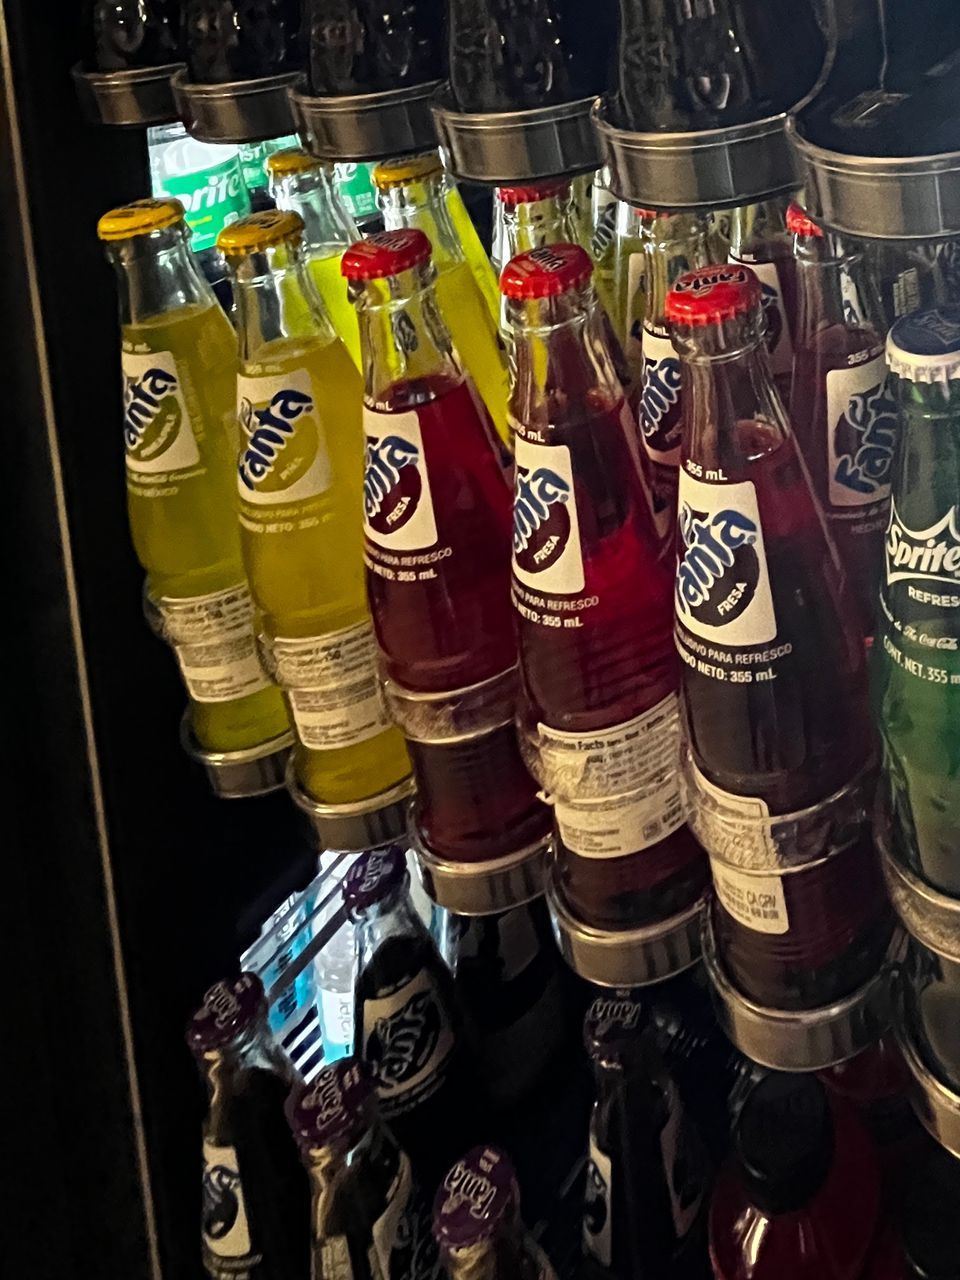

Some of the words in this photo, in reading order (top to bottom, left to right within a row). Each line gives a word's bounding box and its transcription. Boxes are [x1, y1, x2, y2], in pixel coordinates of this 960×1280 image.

[125, 368, 178, 451] anta
[527, 429, 546, 444] mL
[364, 434, 420, 520] anta
[686, 457, 704, 478] 355
[704, 468, 728, 481] mL
[385, 495, 411, 526] FRESA
[512, 467, 570, 554] anta
[533, 534, 561, 566] FRESA
[546, 595, 600, 612] REFRESCO
[716, 581, 748, 616] FRESA
[541, 613, 563, 628] 355
[563, 614, 585, 627] mL
[708, 648, 733, 664] PARA
[735, 643, 793, 665] REFRESCO
[697, 661, 728, 680] NETO:
[730, 670, 753, 683] 355
[755, 666, 778, 682] mL
[904, 657, 927, 681] NET.
[927, 667, 949, 684] 355
[577, 740, 605, 752] Facts
